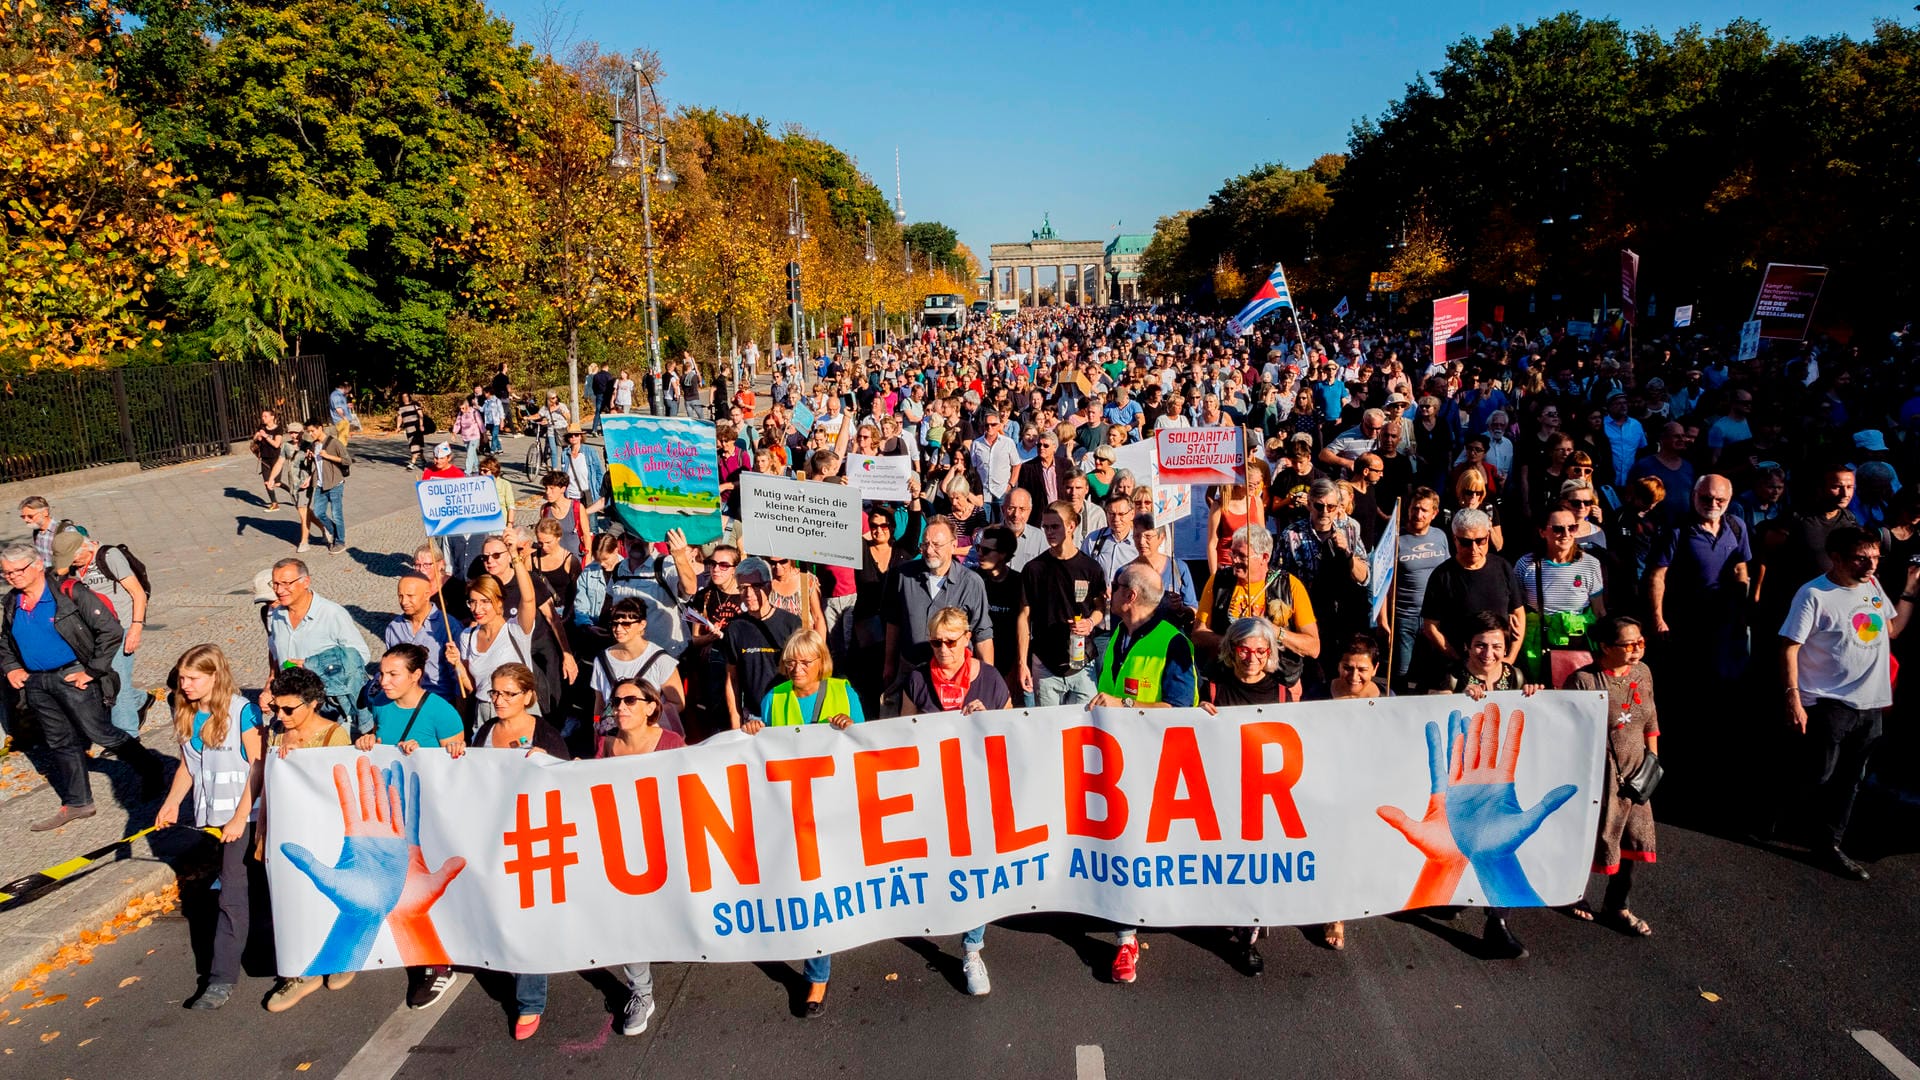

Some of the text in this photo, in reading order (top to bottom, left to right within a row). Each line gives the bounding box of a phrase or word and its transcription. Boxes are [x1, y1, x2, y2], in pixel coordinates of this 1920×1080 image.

[1186, 443, 1219, 454] STATT
[1165, 453, 1242, 466] AUSGRENZUNG
[445, 493, 472, 505] STATT
[753, 488, 848, 508] Mutig warf sich die
[429, 502, 496, 517] AUSGRENZUNG
[765, 501, 836, 517] kleine Kamera
[753, 511, 848, 530] zwischen Angreifer
[775, 524, 827, 537] und Opfer.
[503, 722, 1308, 909] #UNTEILBAR
[713, 848, 1316, 936] SOLIDARITÄT STATT AUSGRENZUNG
